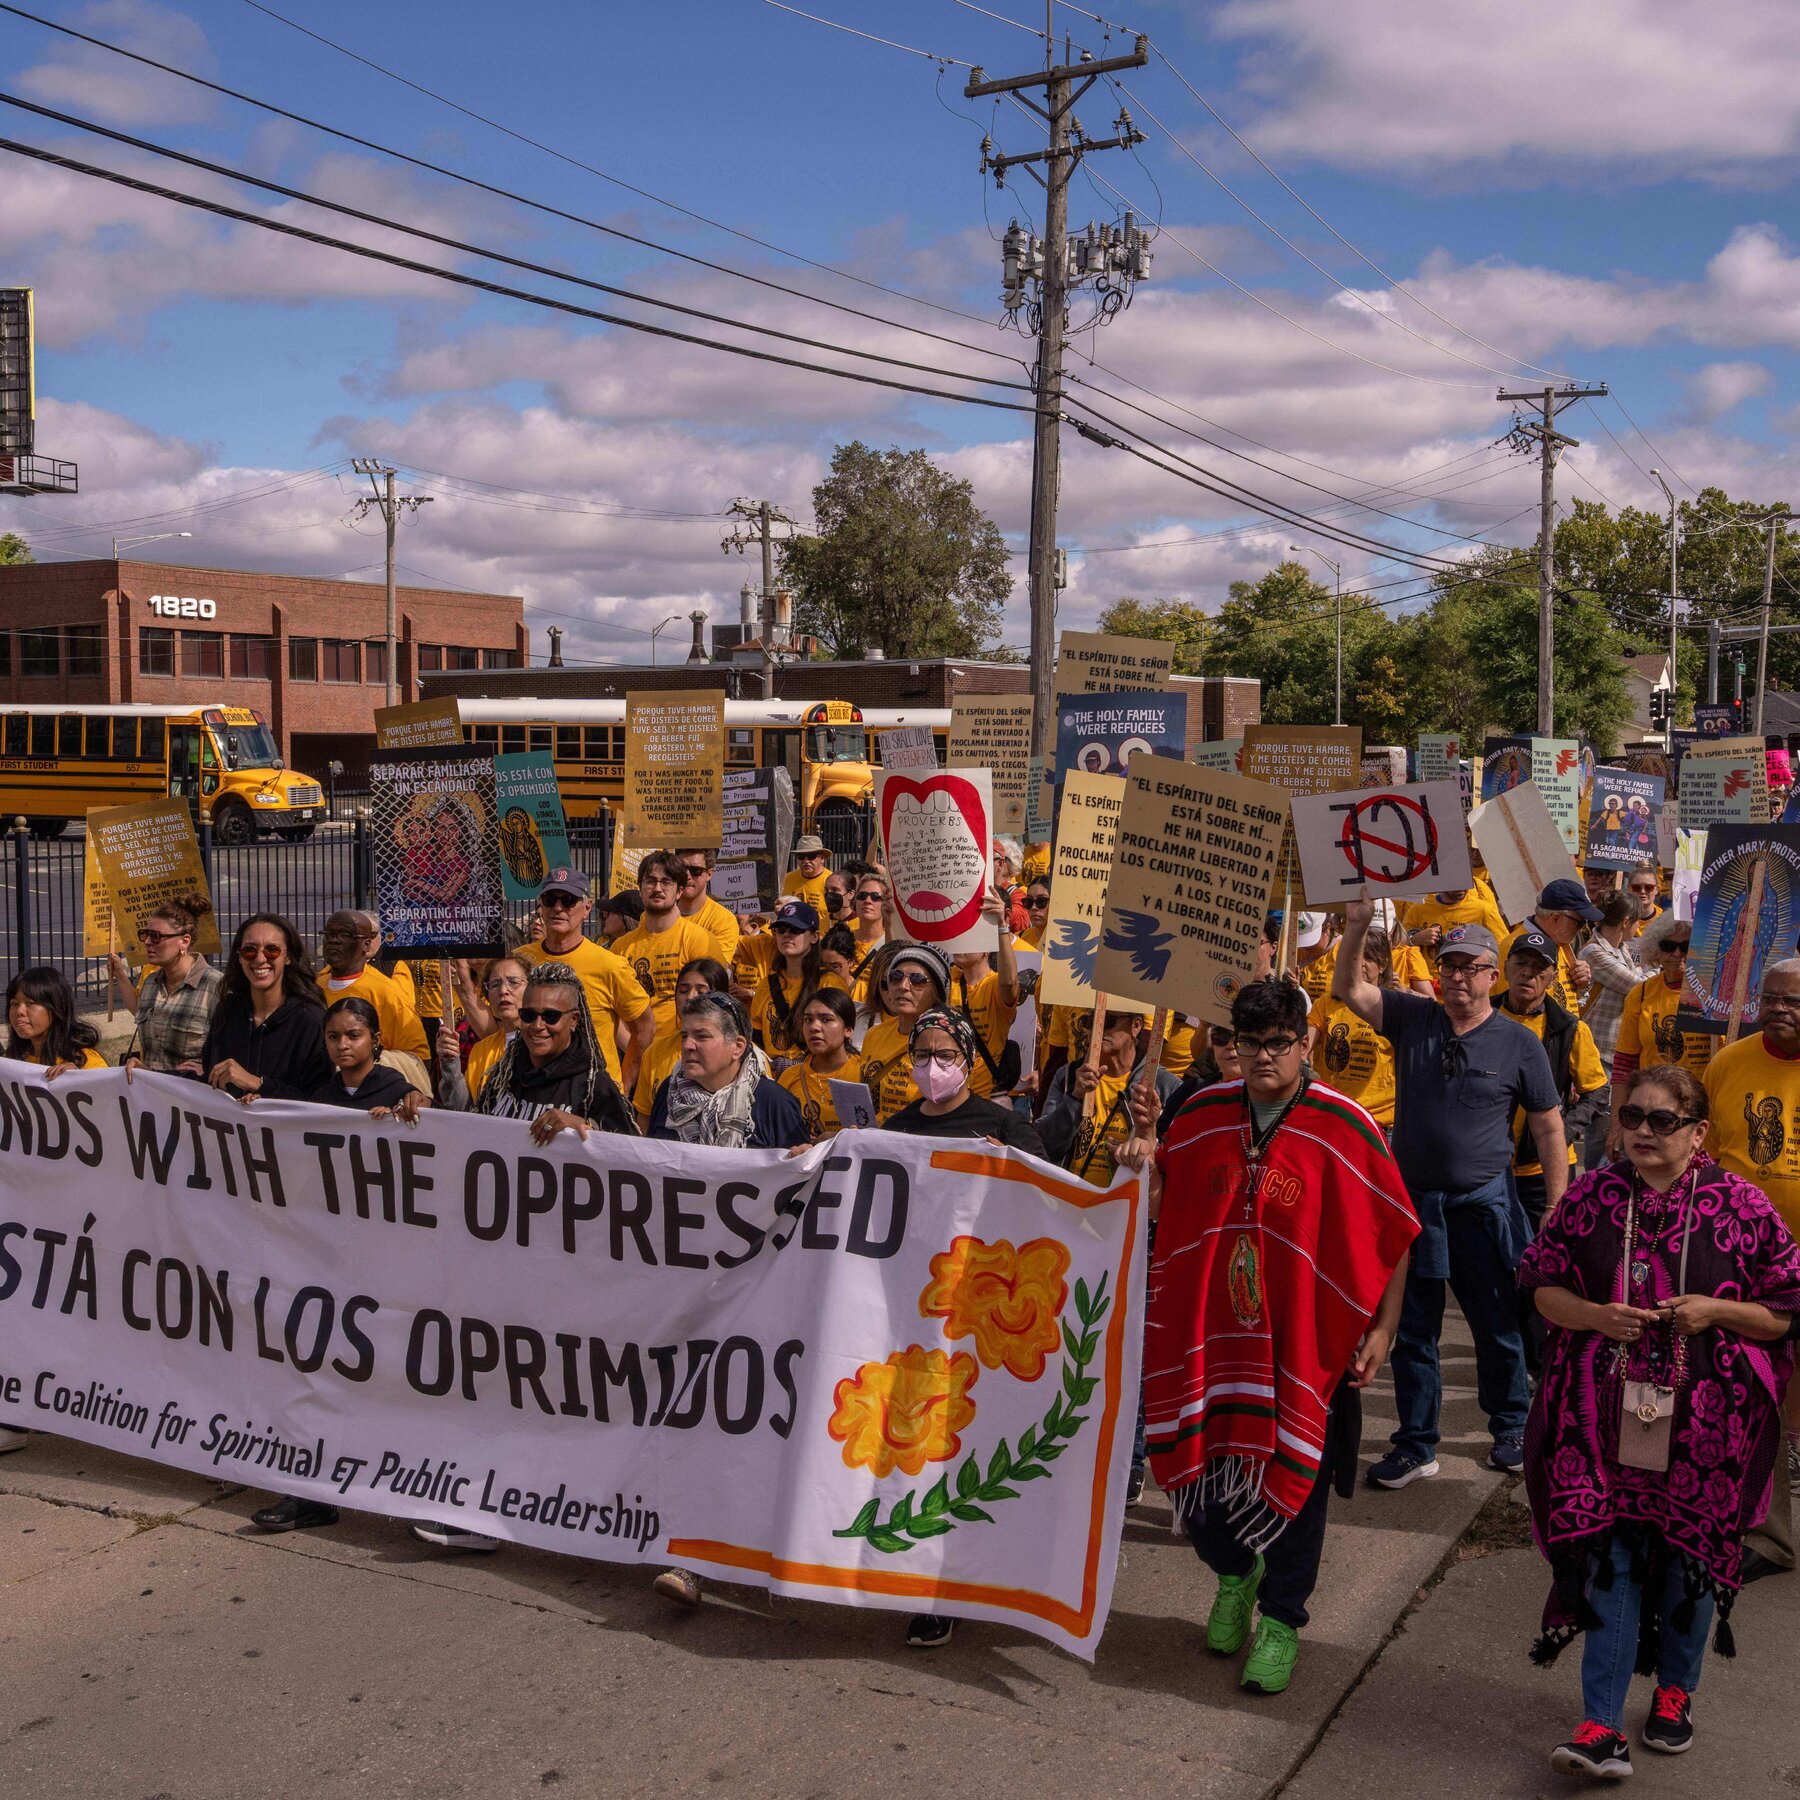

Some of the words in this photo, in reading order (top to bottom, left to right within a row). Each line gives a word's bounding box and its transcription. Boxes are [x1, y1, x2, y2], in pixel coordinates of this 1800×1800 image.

[149, 595, 216, 619] 1820
[1063, 650, 1075, 659] "EL
[1079, 650, 1118, 663] ESPÍRITU
[1121, 656, 1136, 666] DEL
[1140, 657, 1169, 669] SEÑOR
[1090, 666, 1111, 678] ESTÁ
[1114, 669, 1142, 681] SOBRE
[1145, 671, 1163, 683] MÍ...
[223, 712, 244, 722] SCHOOL
[828, 709, 842, 720] SCHOOL
[1075, 712, 1094, 723] THE
[1097, 710, 1123, 721] HOLY
[1127, 710, 1165, 721] FAMILY
[1076, 724, 1107, 735] WERE
[1110, 723, 1166, 734] REFUGEES
[892, 731, 913, 748] SHALL
[915, 728, 932, 746] LOVE
[1252, 744, 1288, 754] "PORQUE
[1292, 745, 1313, 753] TUVE
[1316, 746, 1352, 755] HAMBRE,
[0, 761, 21, 769] FIRST
[23, 761, 58, 769] STUDENT
[882, 754, 894, 769] THE
[927, 748, 936, 765] AS
[1250, 755, 1255, 763] Y
[1258, 755, 1269, 763] ME
[1272, 755, 1305, 764] DISTEIS
[1308, 756, 1319, 765] DE
[1322, 757, 1353, 766] COMER;
[126, 764, 140, 772] 657
[373, 766, 424, 781] SEPARAR
[428, 763, 476, 778] FAMILIAS
[479, 763, 493, 775] ES
[511, 766, 533, 781] ESTÁ
[535, 768, 553, 779] CON
[584, 767, 609, 775] FIRST
[655, 769, 671, 777] WAS
[672, 769, 699, 777] HUNGRY
[1616, 779, 1632, 787] HOLY
[1632, 781, 1654, 789] FAMILY
[1771, 773, 1790, 782] ALL
[394, 780, 410, 795] UN
[414, 777, 476, 793] ESCÁNDALO
[508, 782, 556, 797] OPRIMIDOS
[1604, 784, 1622, 792] WERE
[1624, 787, 1654, 796] REFUGEES
[1132, 777, 1151, 792] "EL
[1157, 782, 1213, 805] ESPÍRITU
[1216, 797, 1238, 813] DEL
[1243, 804, 1282, 825] SEÑOR
[536, 810, 556, 818] STANDS
[686, 812, 700, 820] ME."
[898, 816, 961, 827] PROVERBS
[1171, 805, 1201, 822] ESTÁ
[1206, 813, 1245, 834] SOBRE
[1249, 824, 1273, 843] MÍ...
[1164, 822, 1182, 836] ME
[1186, 827, 1201, 842] HA
[1207, 832, 1262, 859] ENVIADO
[1266, 850, 1274, 863] A
[1121, 832, 1196, 860] PROCLAMAR
[1200, 850, 1258, 878] LIBERTAD
[1262, 869, 1270, 882] A
[1600, 844, 1628, 854] SAGRADA
[1629, 849, 1653, 858] FAMILIA
[1700, 849, 1735, 885] MOTHER
[1737, 840, 1767, 856] MARY,
[1120, 852, 1145, 868] LOS
[1149, 858, 1213, 886] CAUTIVOS,
[1219, 875, 1228, 888] Y
[1232, 879, 1266, 901] VISTA
[725, 890, 744, 898] Cages
[1174, 883, 1183, 896] A
[1187, 887, 1211, 904] LOS
[1216, 895, 1262, 921] CIEGOS,
[386, 906, 452, 920] SEPARATING
[454, 905, 500, 918] FAMILIES
[1142, 895, 1151, 907] Y
[1155, 898, 1162, 911] A
[1167, 901, 1219, 926] LIBERAR
[1223, 917, 1231, 930] A
[1235, 920, 1259, 938] LOS
[411, 922, 422, 934] IS
[426, 922, 434, 933] A
[436, 921, 482, 933] SCANDAL
[1181, 924, 1255, 955] OPRIMIDOS"
[1205, 950, 1233, 965] -LUCAS
[1236, 960, 1252, 972] 4:18
[1685, 966, 1707, 999] MADRE
[1704, 995, 1733, 1015] MARÍA
[118, 1095, 287, 1207] WITH
[304, 1131, 438, 1229] THE
[463, 1149, 910, 1270] OPPRESSED
[121, 1249, 234, 1352] CON
[254, 1276, 380, 1383] LOS
[405, 1308, 805, 1440] OPRIMIDOS
[34, 1372, 149, 1435] Coalition
[151, 1401, 196, 1449] for
[200, 1413, 325, 1478] Spiritual
[370, 1450, 470, 1508] Public
[480, 1469, 660, 1552] Leadership
